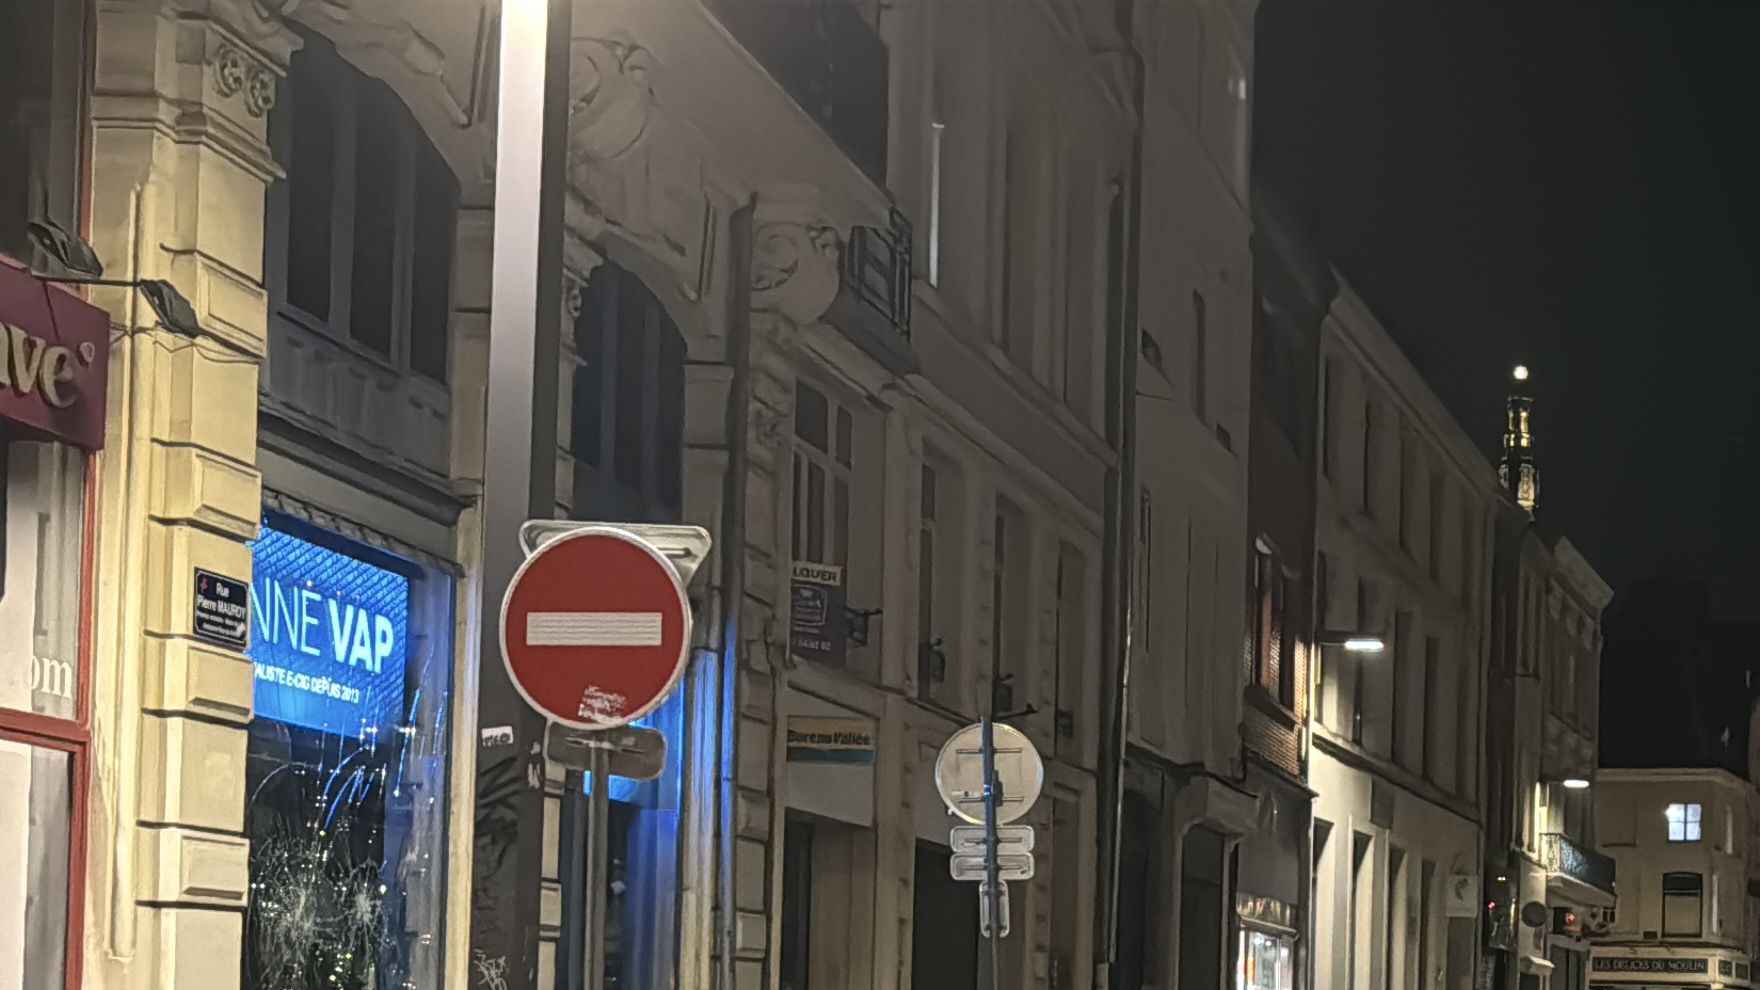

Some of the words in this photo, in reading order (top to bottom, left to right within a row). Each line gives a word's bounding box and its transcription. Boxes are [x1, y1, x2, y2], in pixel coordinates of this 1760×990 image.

[216, 582, 229, 598] Rue
[197, 594, 217, 612] Pierre
[217, 600, 247, 619] MAUROY
[328, 598, 394, 674] VAP
[286, 671, 310, 691] E-CIG
[311, 676, 341, 699] DEPUIS
[341, 685, 359, 704] 2013
[1651, 959, 1665, 970] DU
[1667, 960, 1705, 971] MOULIN
